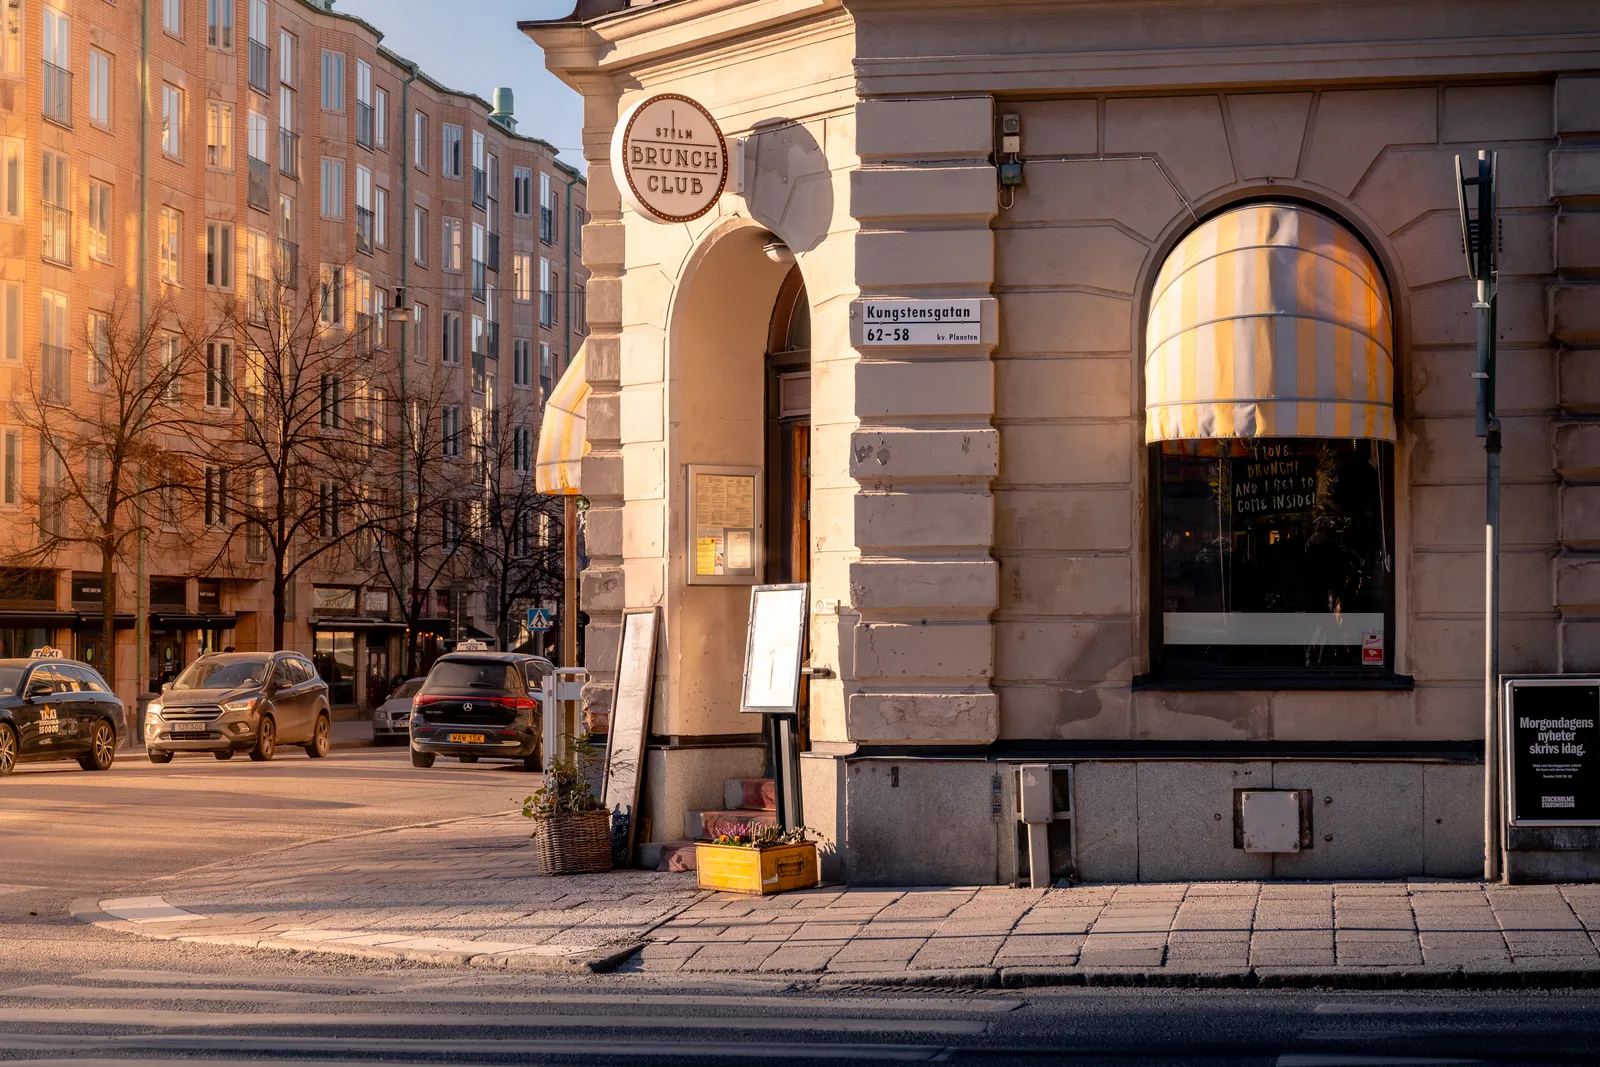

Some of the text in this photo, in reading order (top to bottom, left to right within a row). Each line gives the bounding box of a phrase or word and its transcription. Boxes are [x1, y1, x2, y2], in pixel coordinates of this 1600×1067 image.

[631, 146, 718, 169] BRUNCH
[647, 175, 703, 195] CLUB
[867, 305, 970, 321] Kungstensgatan
[867, 328, 910, 341] 62-58
[1235, 481, 1258, 498] AND
[1237, 499, 1268, 513] COME
[34, 650, 59, 658] TAXI
[1519, 717, 1593, 730] Morgondagens
[1537, 730, 1576, 743] nyheter
[1529, 742, 1586, 756] skrivs idag.
